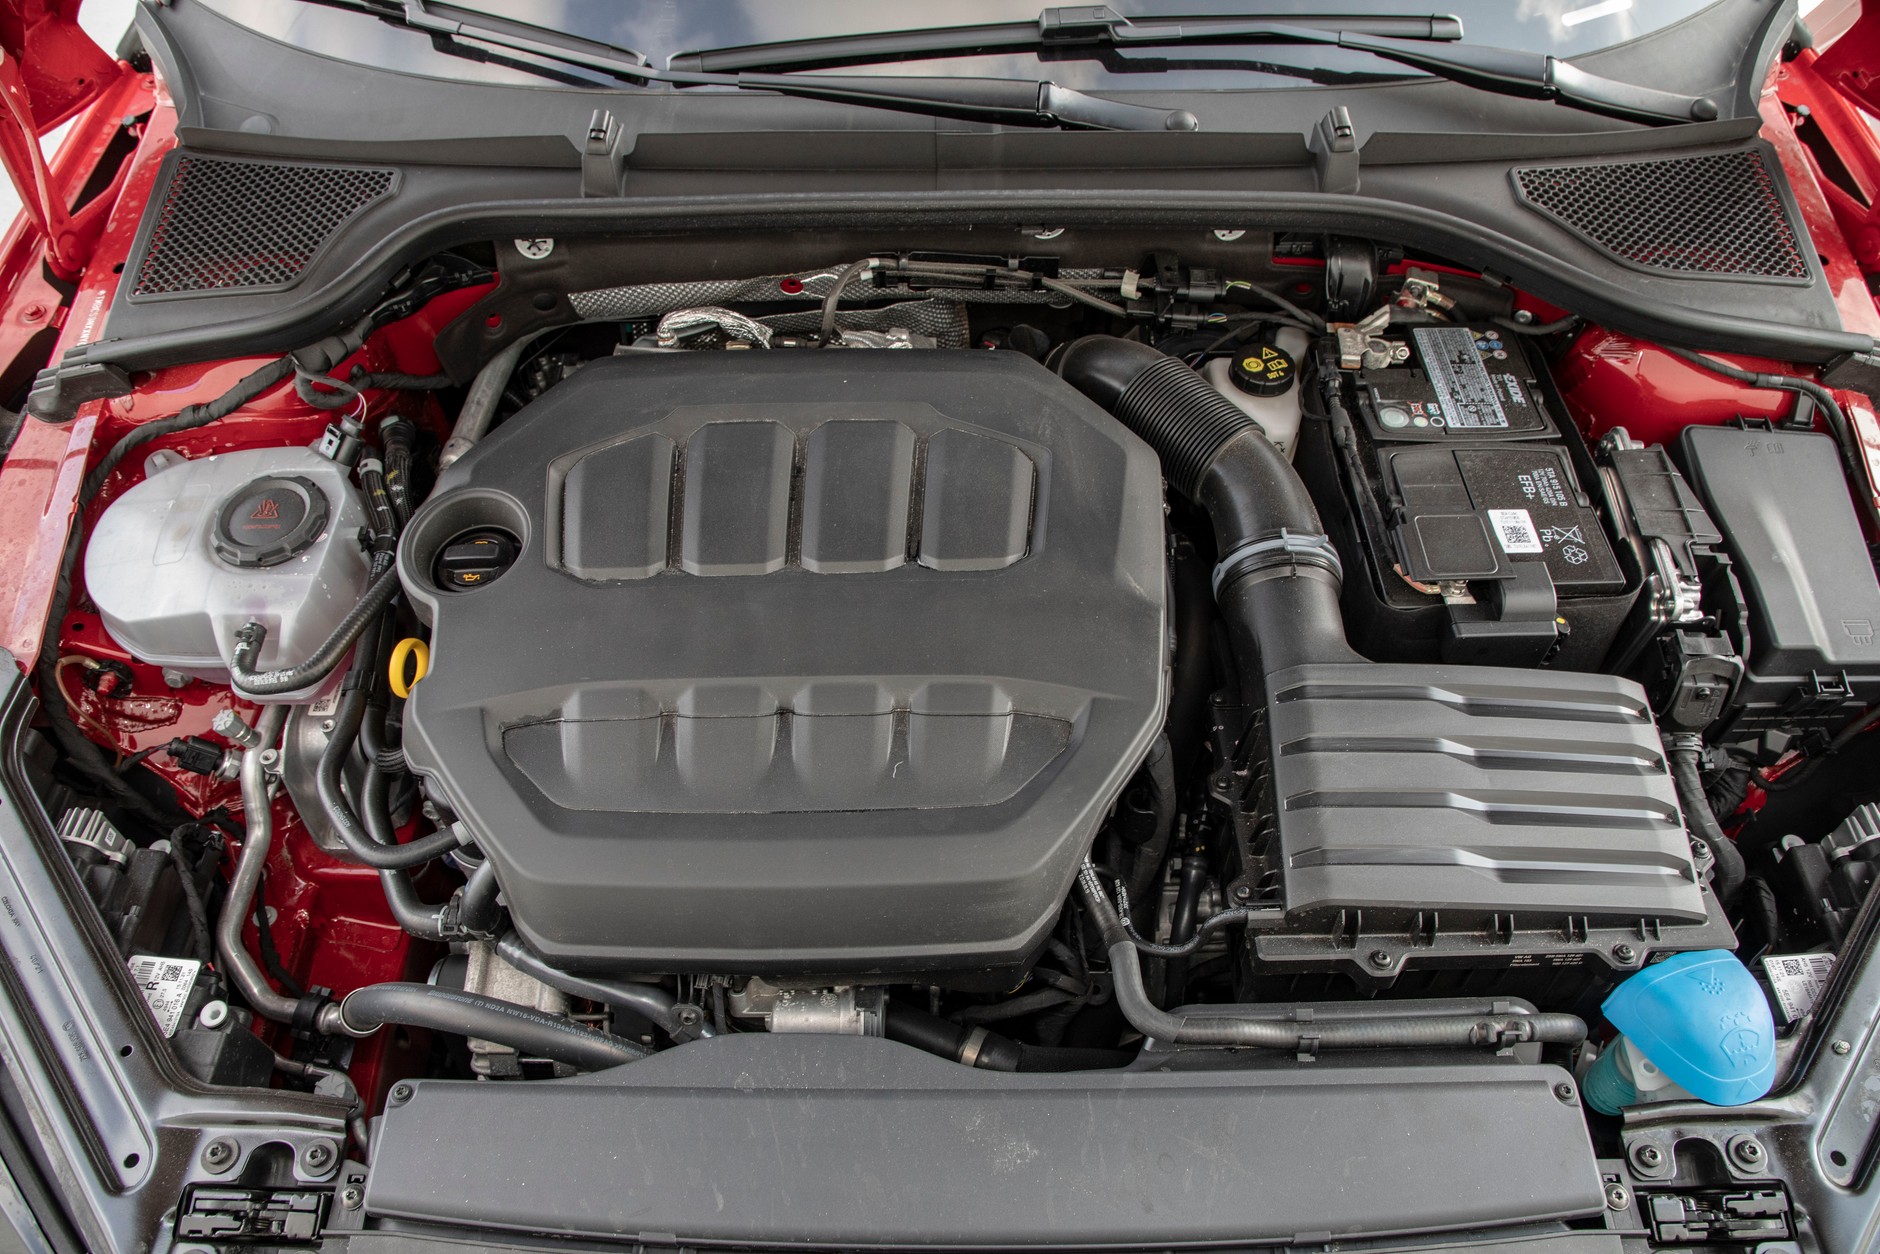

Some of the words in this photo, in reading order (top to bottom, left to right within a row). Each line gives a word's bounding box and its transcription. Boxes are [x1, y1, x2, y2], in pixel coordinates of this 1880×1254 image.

[1503, 373, 1526, 404] EXIDE
[1545, 468, 1556, 478] 5TA
[1518, 475, 1536, 500] EFB+
[1550, 479, 1561, 490] 915
[1555, 490, 1566, 500] 105
[1540, 529, 1552, 542] Pb
[145, 981, 160, 990] R
[427, 990, 474, 1004] BRIDGESTONE
